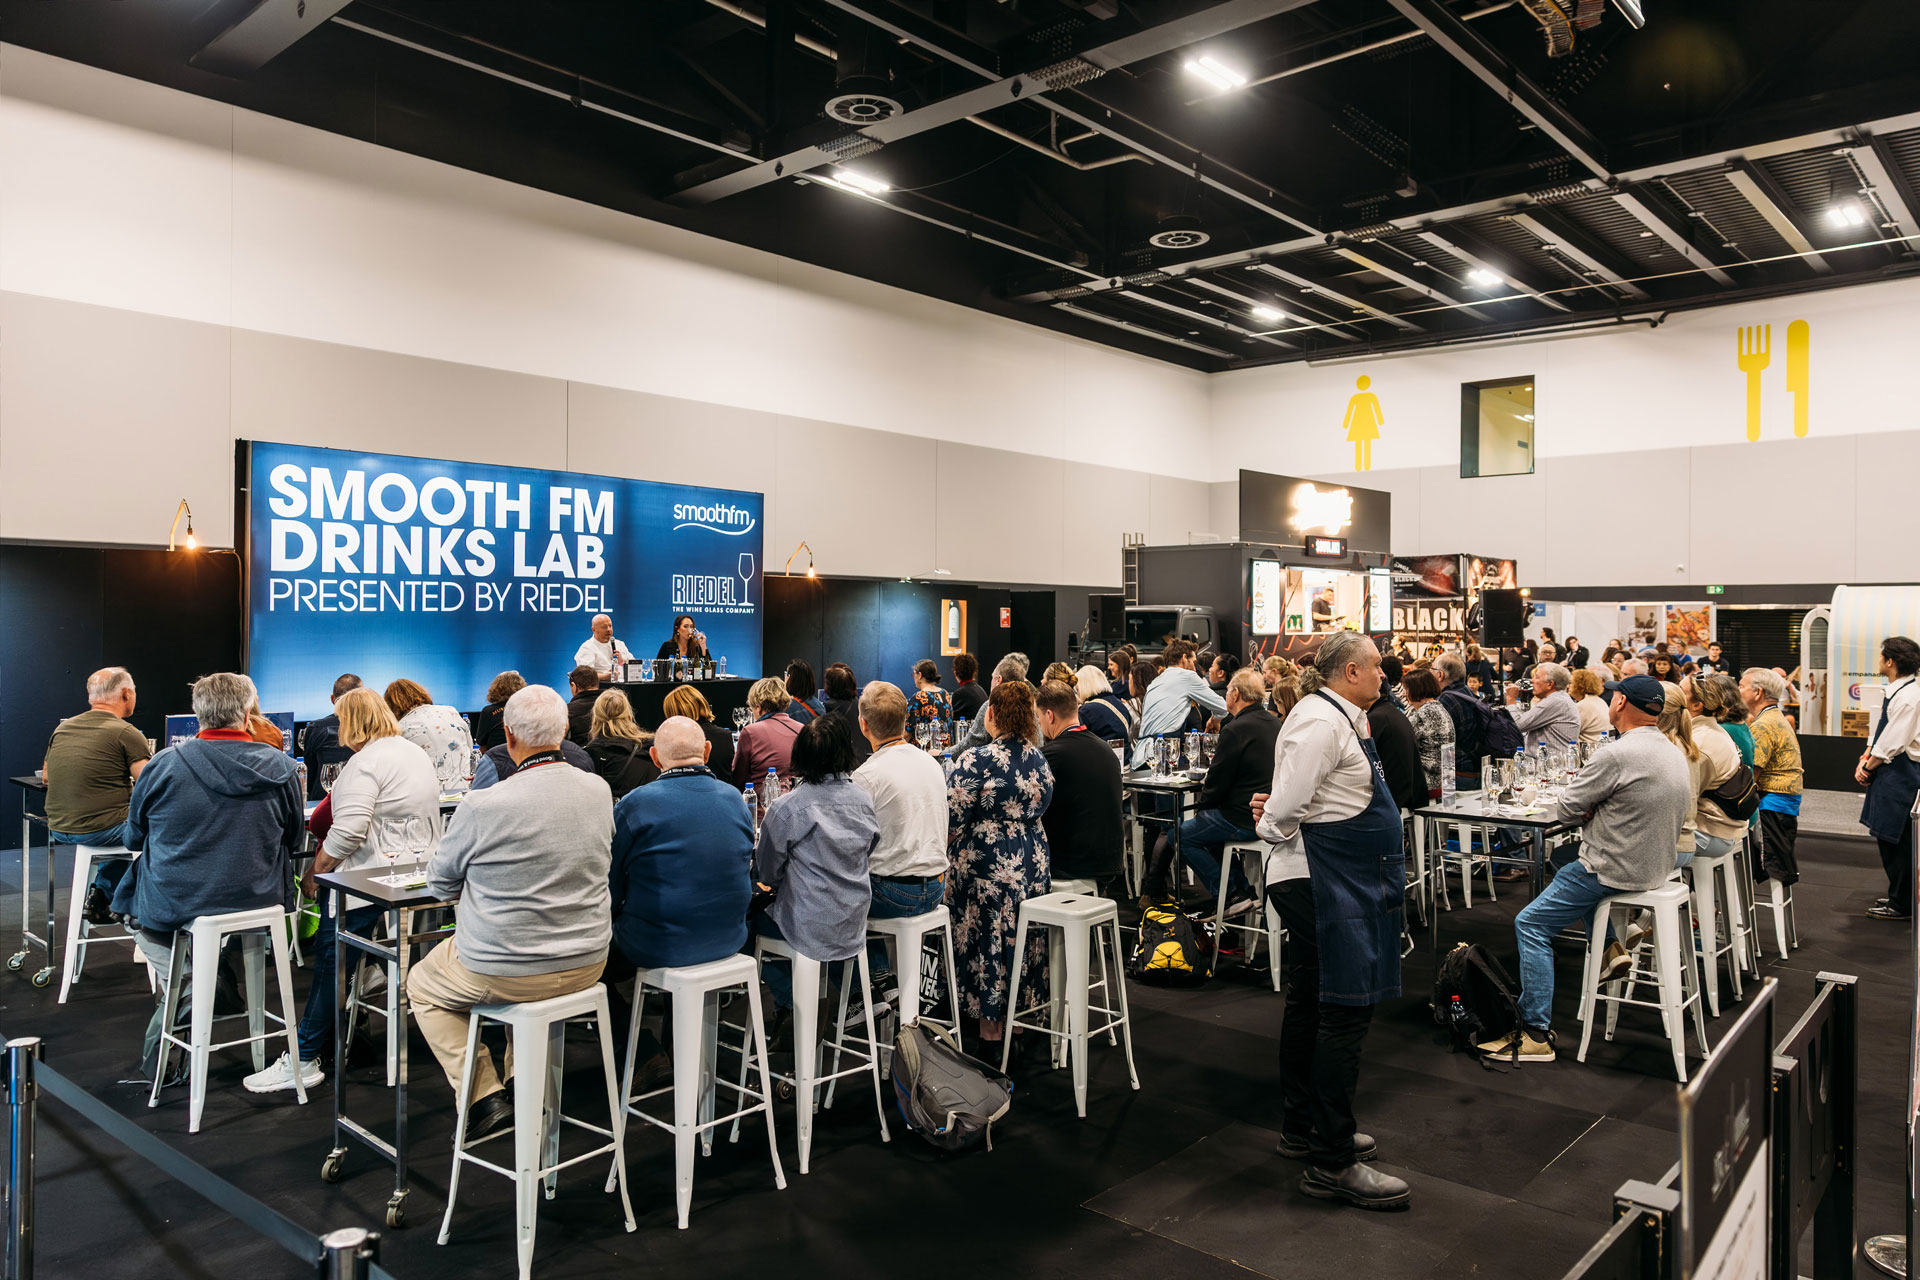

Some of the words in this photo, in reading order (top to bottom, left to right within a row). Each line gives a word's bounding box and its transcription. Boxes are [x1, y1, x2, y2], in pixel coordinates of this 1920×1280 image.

[269, 464, 531, 530] SMOOTH
[550, 486, 614, 535] FM
[673, 503, 750, 525] smoothfm
[271, 519, 496, 577] DRINKS
[514, 531, 606, 579] LAB
[269, 578, 465, 612] PRESENTED
[475, 582, 513, 612] BY
[521, 583, 613, 613] RIEDEL
[672, 574, 737, 606] RIEDEL
[1392, 607, 1464, 631] BLACK
